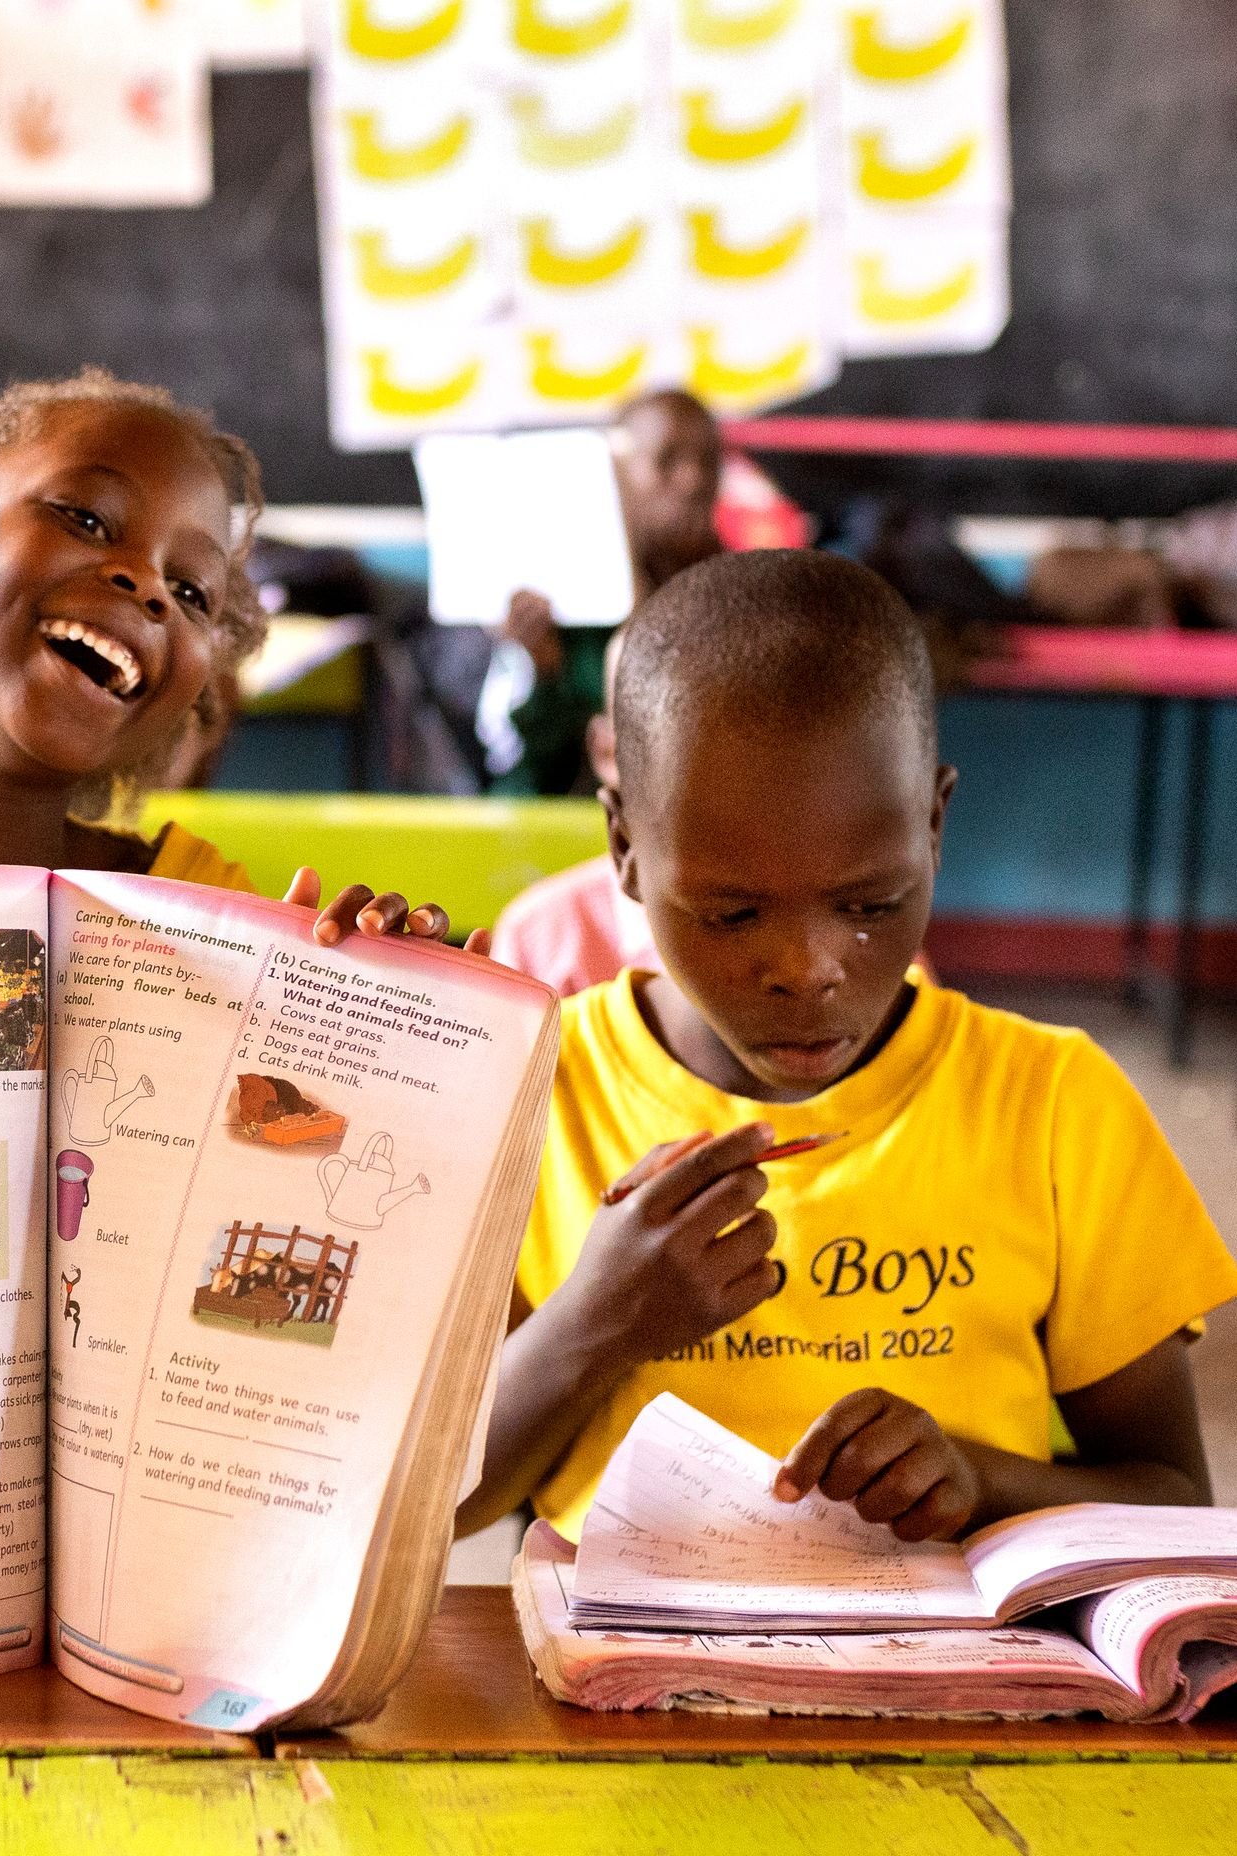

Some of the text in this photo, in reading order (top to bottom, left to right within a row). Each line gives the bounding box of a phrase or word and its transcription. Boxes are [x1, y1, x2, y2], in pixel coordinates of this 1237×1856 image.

[73, 931, 176, 956] Caring for plants
[76, 910, 256, 956] Caring for the environment.
[86, 954, 109, 967] care
[114, 956, 130, 968] for
[133, 961, 172, 977] plants
[73, 972, 243, 1011] Watering flower beds at
[299, 959, 437, 1008] Caring for animals.
[64, 992, 94, 1006] school.
[284, 971, 493, 1042] Watering and feeding animals.
[78, 1017, 182, 1042] water plants using
[280, 1004, 386, 1045] Cows eat grass.
[283, 988, 468, 1051] What do animals feed on?
[270, 1019, 380, 1060] Hens eat grains.
[258, 1051, 363, 1089] Cats drink milk.
[264, 1035, 439, 1094] Dogs eat bones and meat.
[3, 1079, 18, 1091] the
[116, 1124, 195, 1148] Watering can
[96, 1229, 129, 1245] Bucket
[811, 1236, 974, 1315] Boys
[1, 1288, 34, 1303] clothes.
[88, 1336, 128, 1355] Sprinkler.
[724, 1331, 870, 1362] Memorial
[881, 1326, 955, 1359] 2022
[170, 1352, 220, 1375] Activity
[16, 1394, 31, 1406] sick
[67, 1396, 82, 1410] plants
[84, 1400, 100, 1415] when
[165, 1371, 360, 1423] Name two things we can use
[176, 1392, 329, 1436] feed and water animals.
[95, 1428, 112, 1442] wet)
[90, 1451, 123, 1468] watering
[149, 1446, 337, 1497] How do we clean things for
[10, 1477, 32, 1490] make
[145, 1466, 332, 1515] watering and feeding animals?
[1, 1541, 29, 1557] parent
[1, 1562, 29, 1577] money
[221, 1700, 247, 1716] 163
